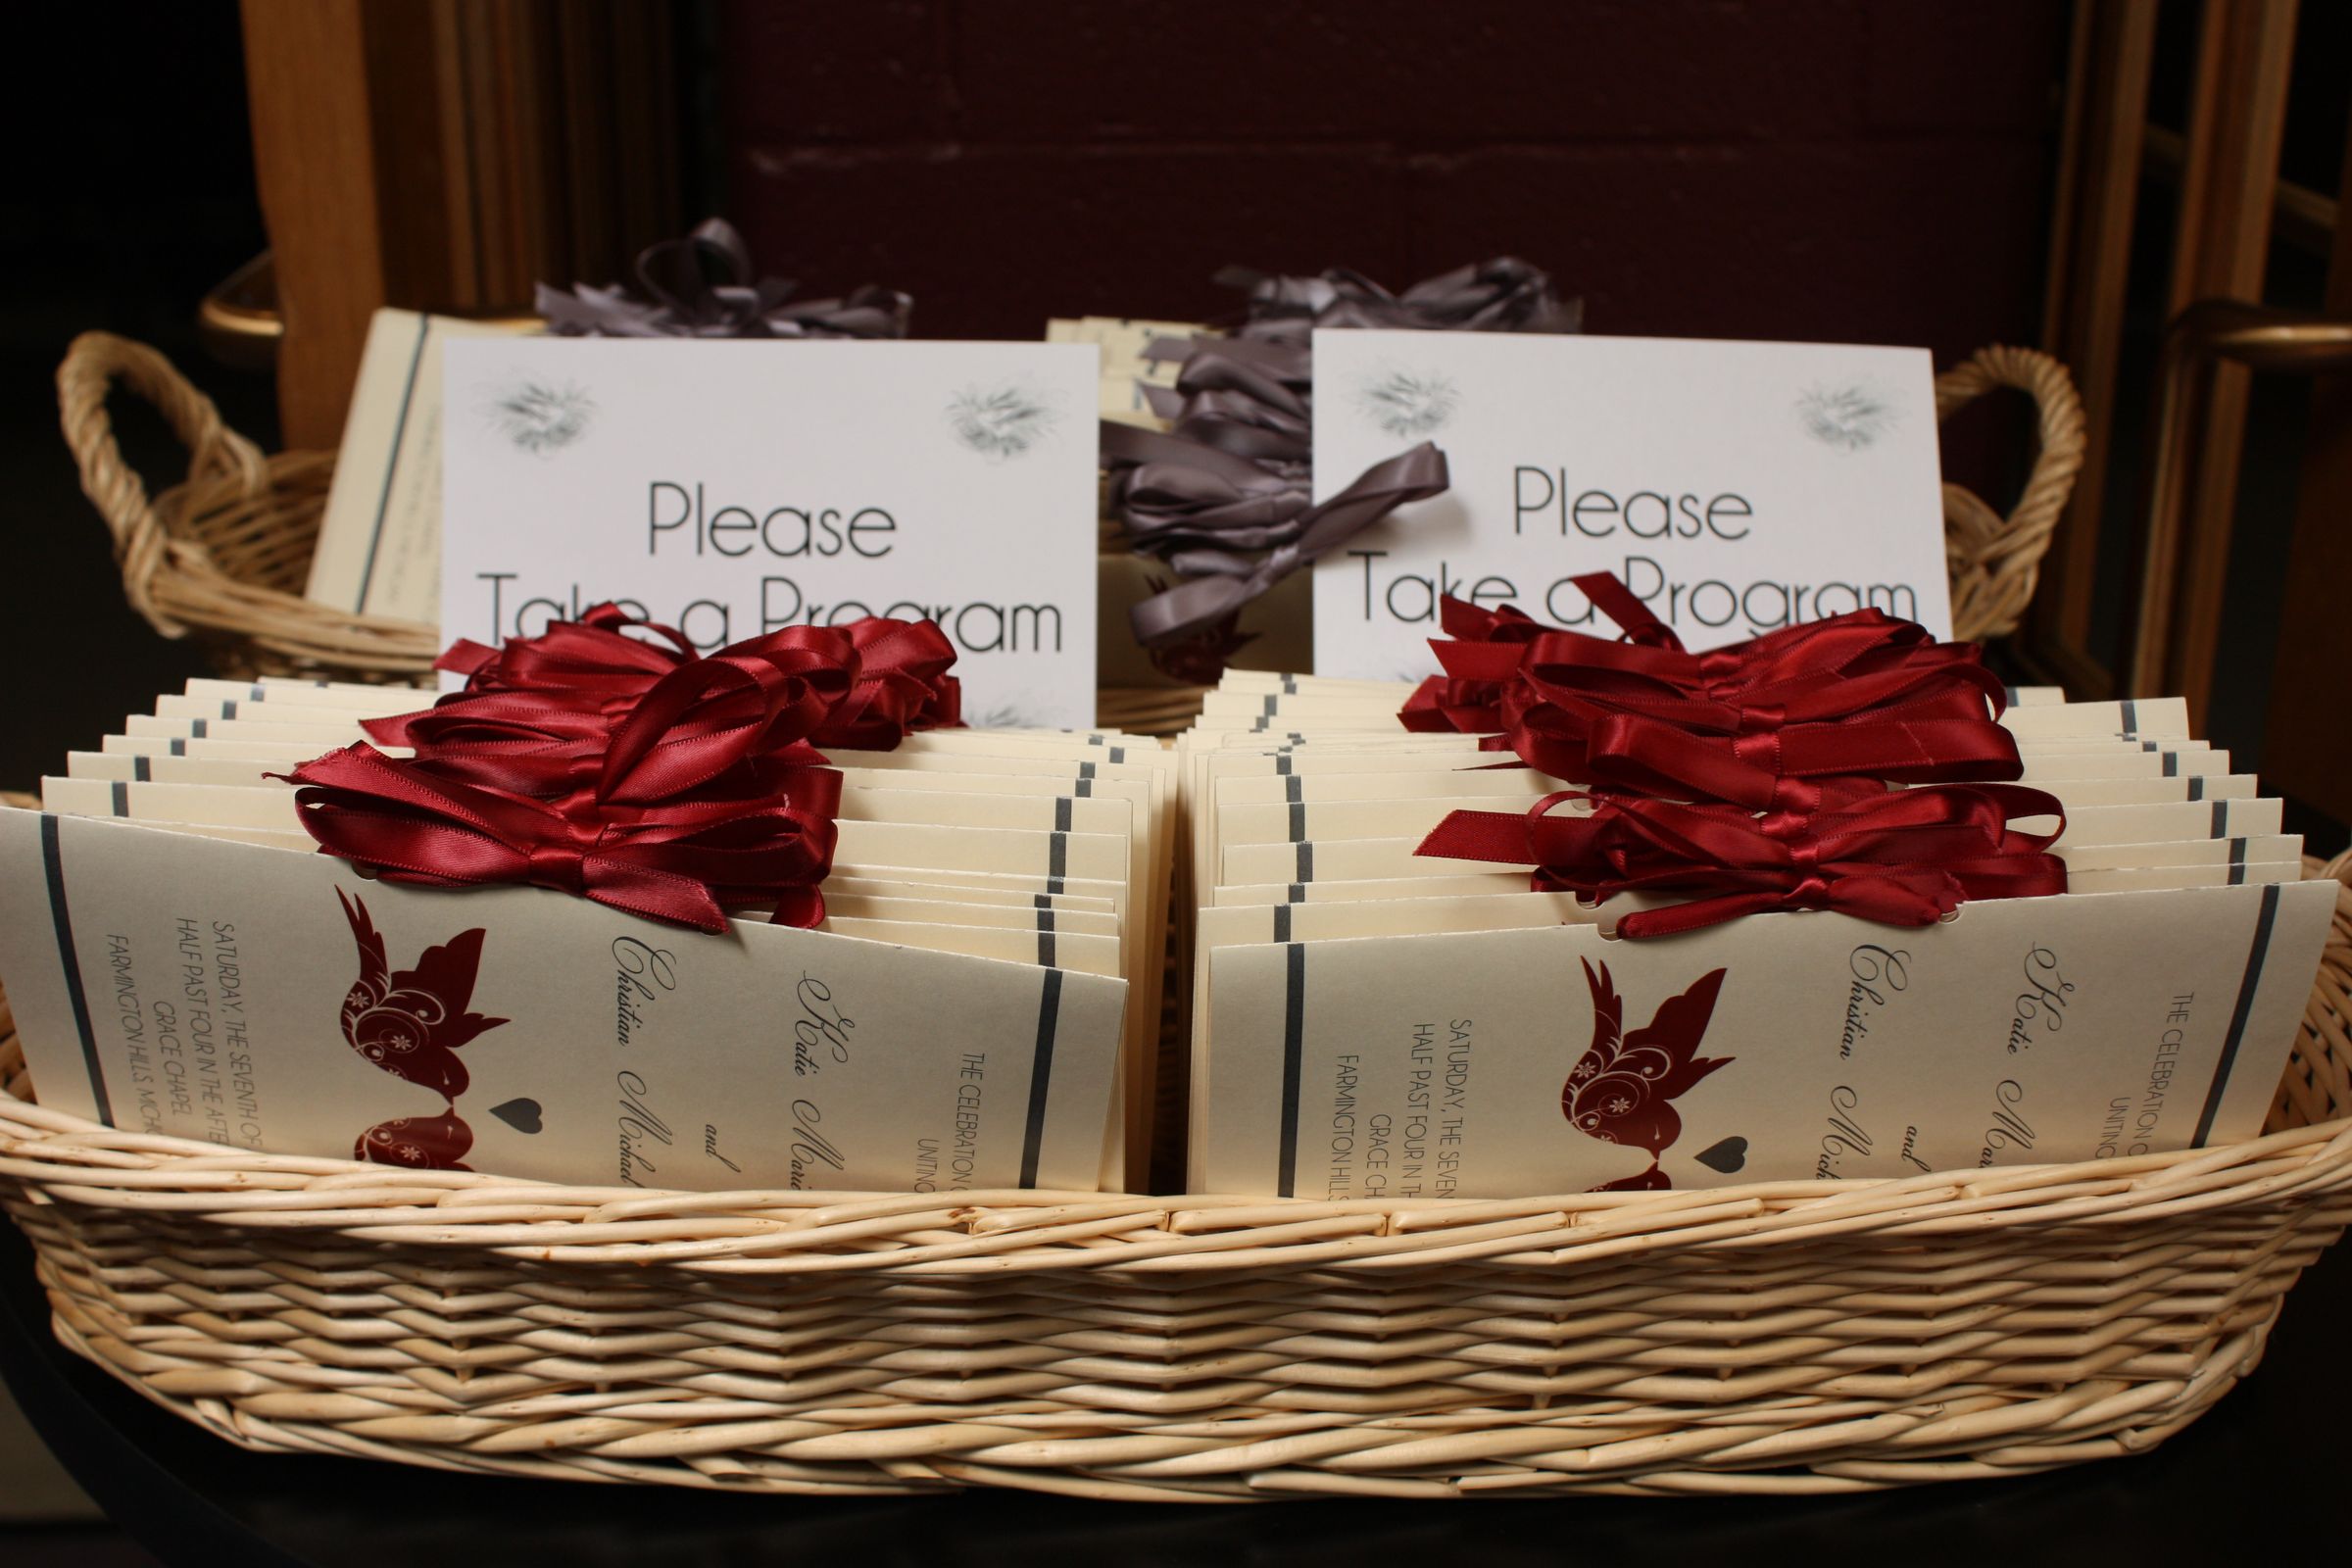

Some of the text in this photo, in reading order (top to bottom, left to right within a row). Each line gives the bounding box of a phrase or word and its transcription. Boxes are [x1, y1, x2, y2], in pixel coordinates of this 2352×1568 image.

[648, 481, 896, 557] Please
[1514, 466, 1752, 540] Please
[1347, 550, 1918, 637] Take a Program
[679, 600, 729, 649] a
[175, 917, 202, 962] HALF
[106, 934, 145, 1042] FARMINGTON
[127, 1044, 154, 1083] HILLS
[182, 964, 209, 1006] PAST
[612, 936, 676, 1047] Christian
[1839, 944, 1911, 1060] Christian
[2007, 941, 2076, 1055] Katie
[2166, 991, 2195, 1023] THE
[189, 1009, 216, 1055] FOUR
[212, 919, 263, 1147] SATURDAY, THE SEVENTH OF
[795, 970, 856, 1077] Katie
[1411, 1023, 1435, 1064] HALF
[153, 1000, 193, 1116] GRACE CHAPEL
[198, 1057, 218, 1074] IN
[960, 1053, 985, 1080] THE
[1441, 1018, 1472, 1112] SATURDAY,
[2133, 1029, 2183, 1139] CELEBRATION
[199, 1078, 224, 1104] THE
[1332, 1054, 1359, 1163] FARMINGTON
[1407, 1070, 1432, 1109] PAST
[705, 1124, 741, 1173] and
[952, 1084, 982, 1183] CELEBRATION
[1366, 1113, 1392, 1169] GRACE
[1403, 1115, 1427, 1160] FOUR
[1439, 1116, 1463, 1146] THE
[1900, 1125, 1932, 1172] and
[1402, 1164, 1423, 1178] IN
